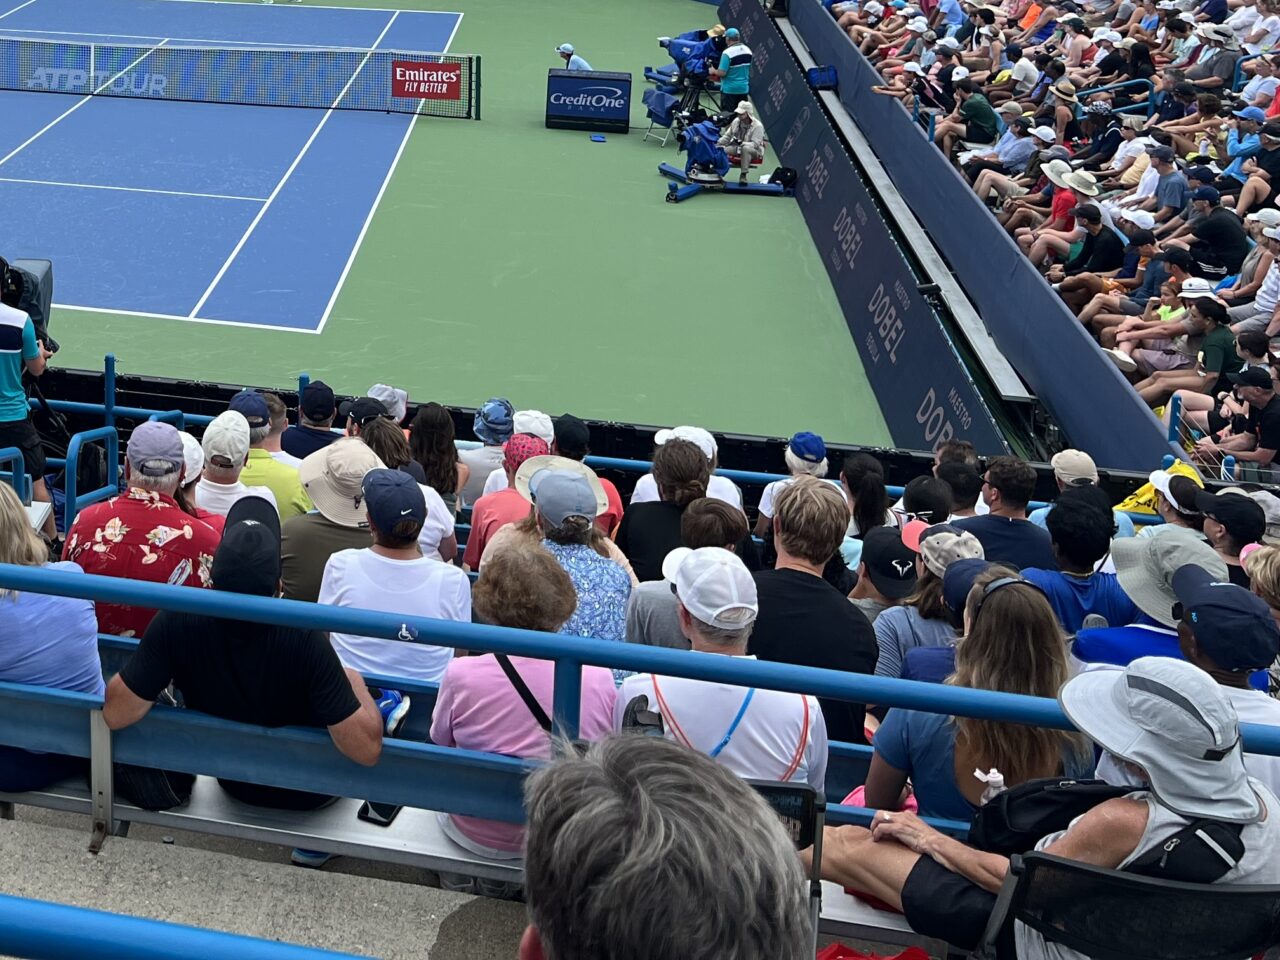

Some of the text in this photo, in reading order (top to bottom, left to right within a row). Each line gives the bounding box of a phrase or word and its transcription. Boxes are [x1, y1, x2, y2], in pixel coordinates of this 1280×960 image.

[27, 67, 168, 96] ATP TOUR
[395, 67, 458, 83] Emirates
[404, 81, 448, 94] FLY BETTER
[549, 92, 625, 109] CreditOne
[833, 206, 863, 270] DOBEL
[894, 279, 911, 312] MAESTRO
[867, 283, 906, 365] DOBEL
[948, 387, 972, 430] MAESTRO
